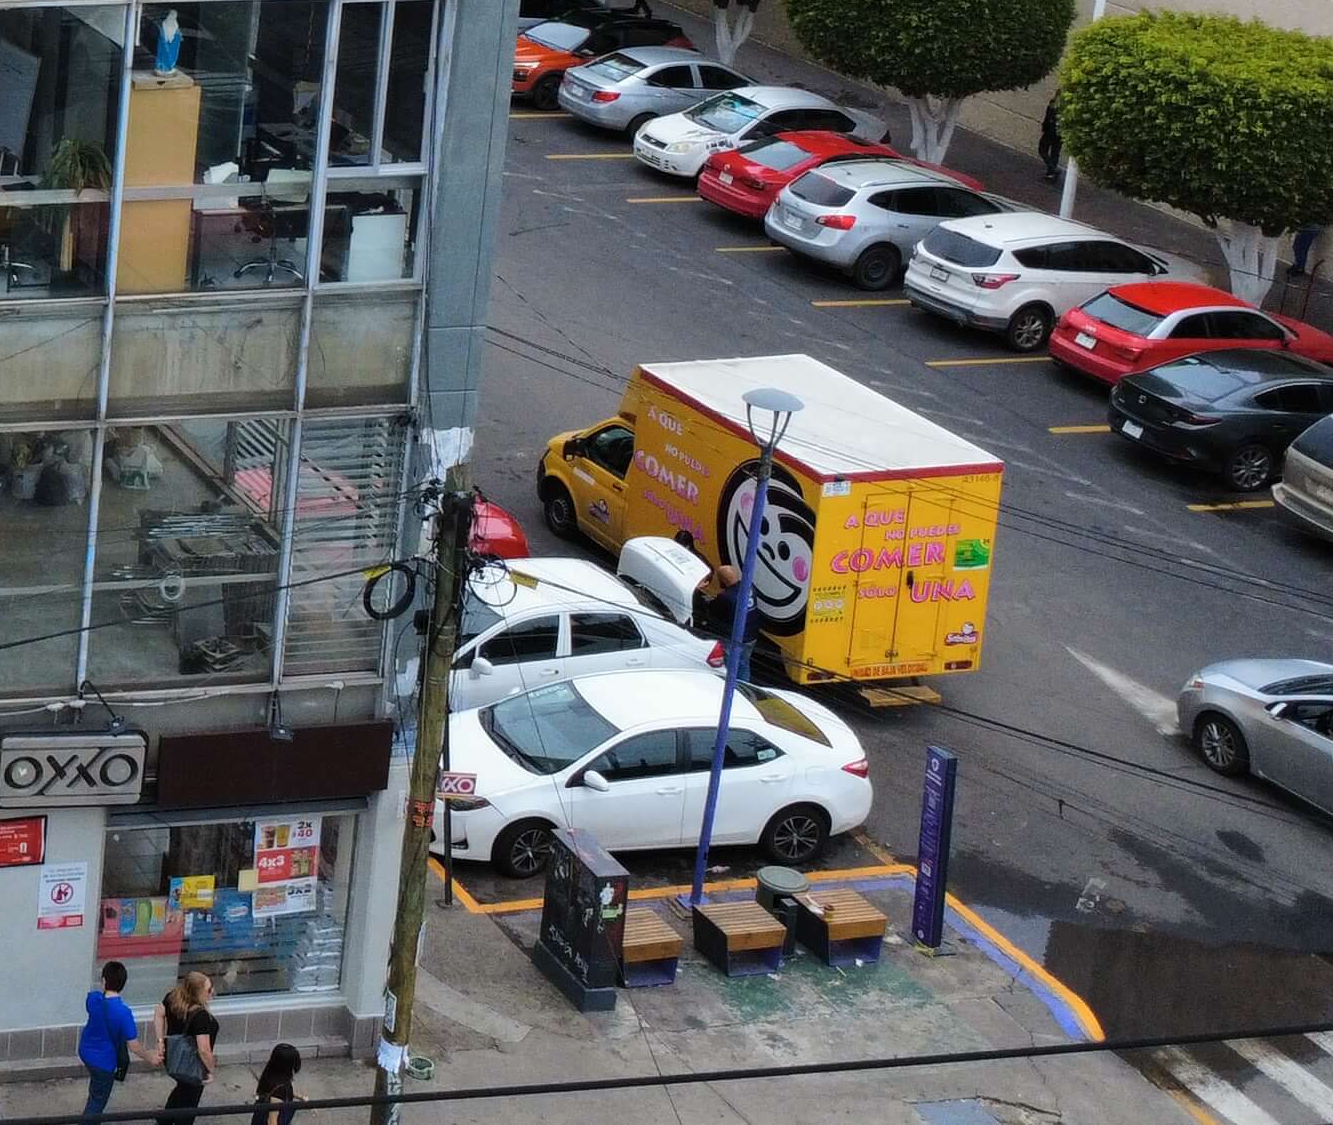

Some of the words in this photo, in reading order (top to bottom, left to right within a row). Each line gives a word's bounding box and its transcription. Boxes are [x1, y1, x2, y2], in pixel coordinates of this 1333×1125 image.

[647, 406, 656, 421] A
[659, 412, 683, 436] QUE
[664, 442, 678, 457] NO
[635, 450, 700, 507] COMER
[844, 515, 859, 529] A
[864, 508, 905, 527] QUE
[885, 530, 905, 540] NO
[909, 524, 961, 539] PUEDES
[830, 541, 945, 573] COMER
[910, 579, 976, 603] UNA
[4, 748, 139, 795] OXXO
